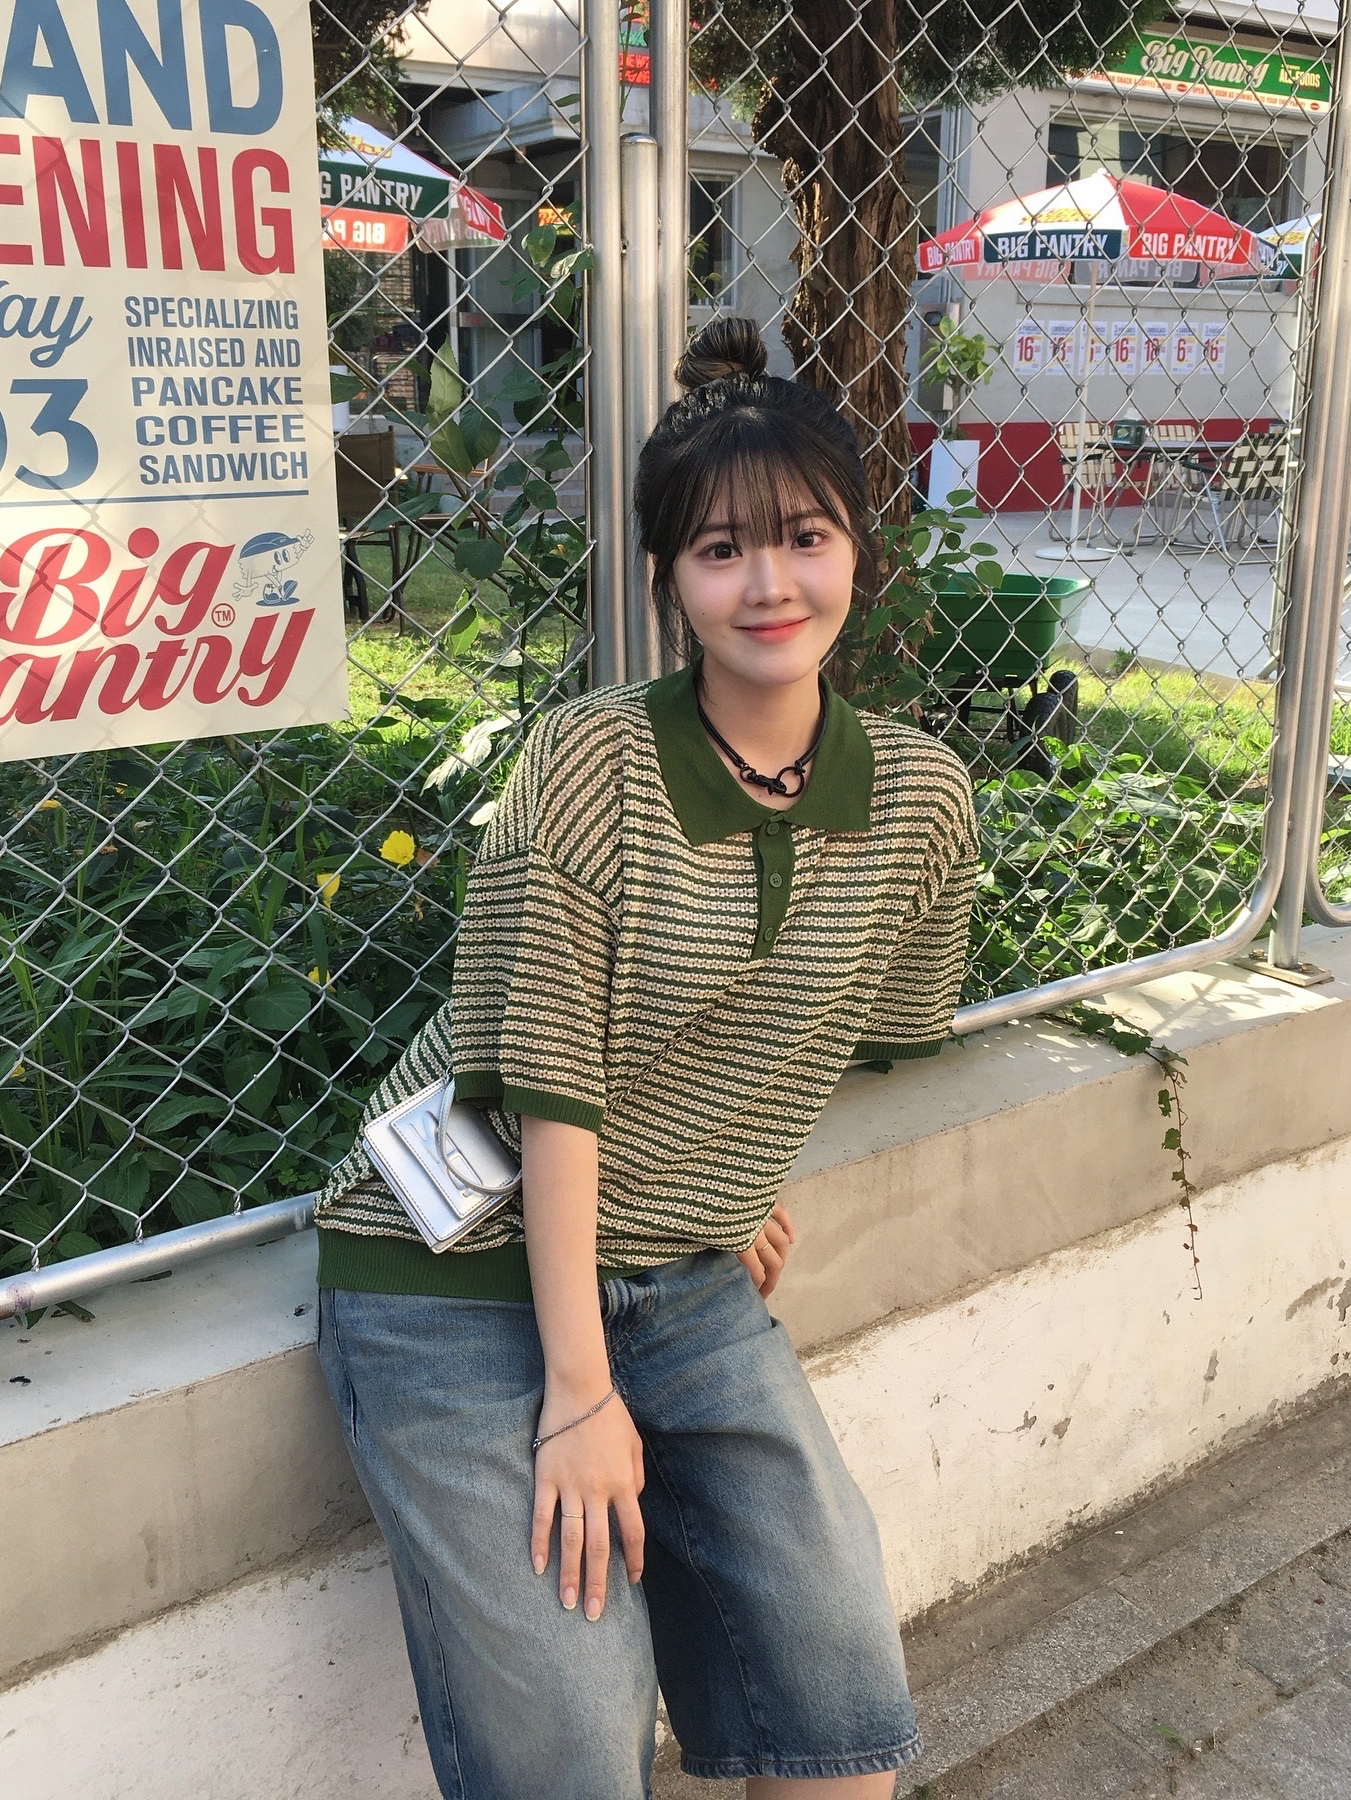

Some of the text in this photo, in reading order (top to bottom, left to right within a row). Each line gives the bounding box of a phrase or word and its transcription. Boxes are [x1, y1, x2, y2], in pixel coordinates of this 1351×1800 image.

[0, 0, 284, 136] AND
[1141, 40, 1270, 88] Big Pantry
[340, 173, 423, 211] PANTRY
[927, 245, 943, 267] BIG
[997, 233, 1109, 260] BIG PANTRY
[1141, 232, 1169, 256] BIG
[1173, 233, 1237, 260] PANTRY
[0, 280, 93, 368] ay
[124, 296, 299, 330] SPECIALIZING
[128, 337, 301, 368] INRAISED AND
[1017, 336, 1034, 362] 16
[1114, 337, 1129, 362] 16
[131, 376, 304, 407] PANCAKE
[0, 379, 99, 490] 3
[135, 414, 306, 446] COFFEE
[140, 451, 308, 485] SANDWICH
[0, 527, 236, 646] Big
